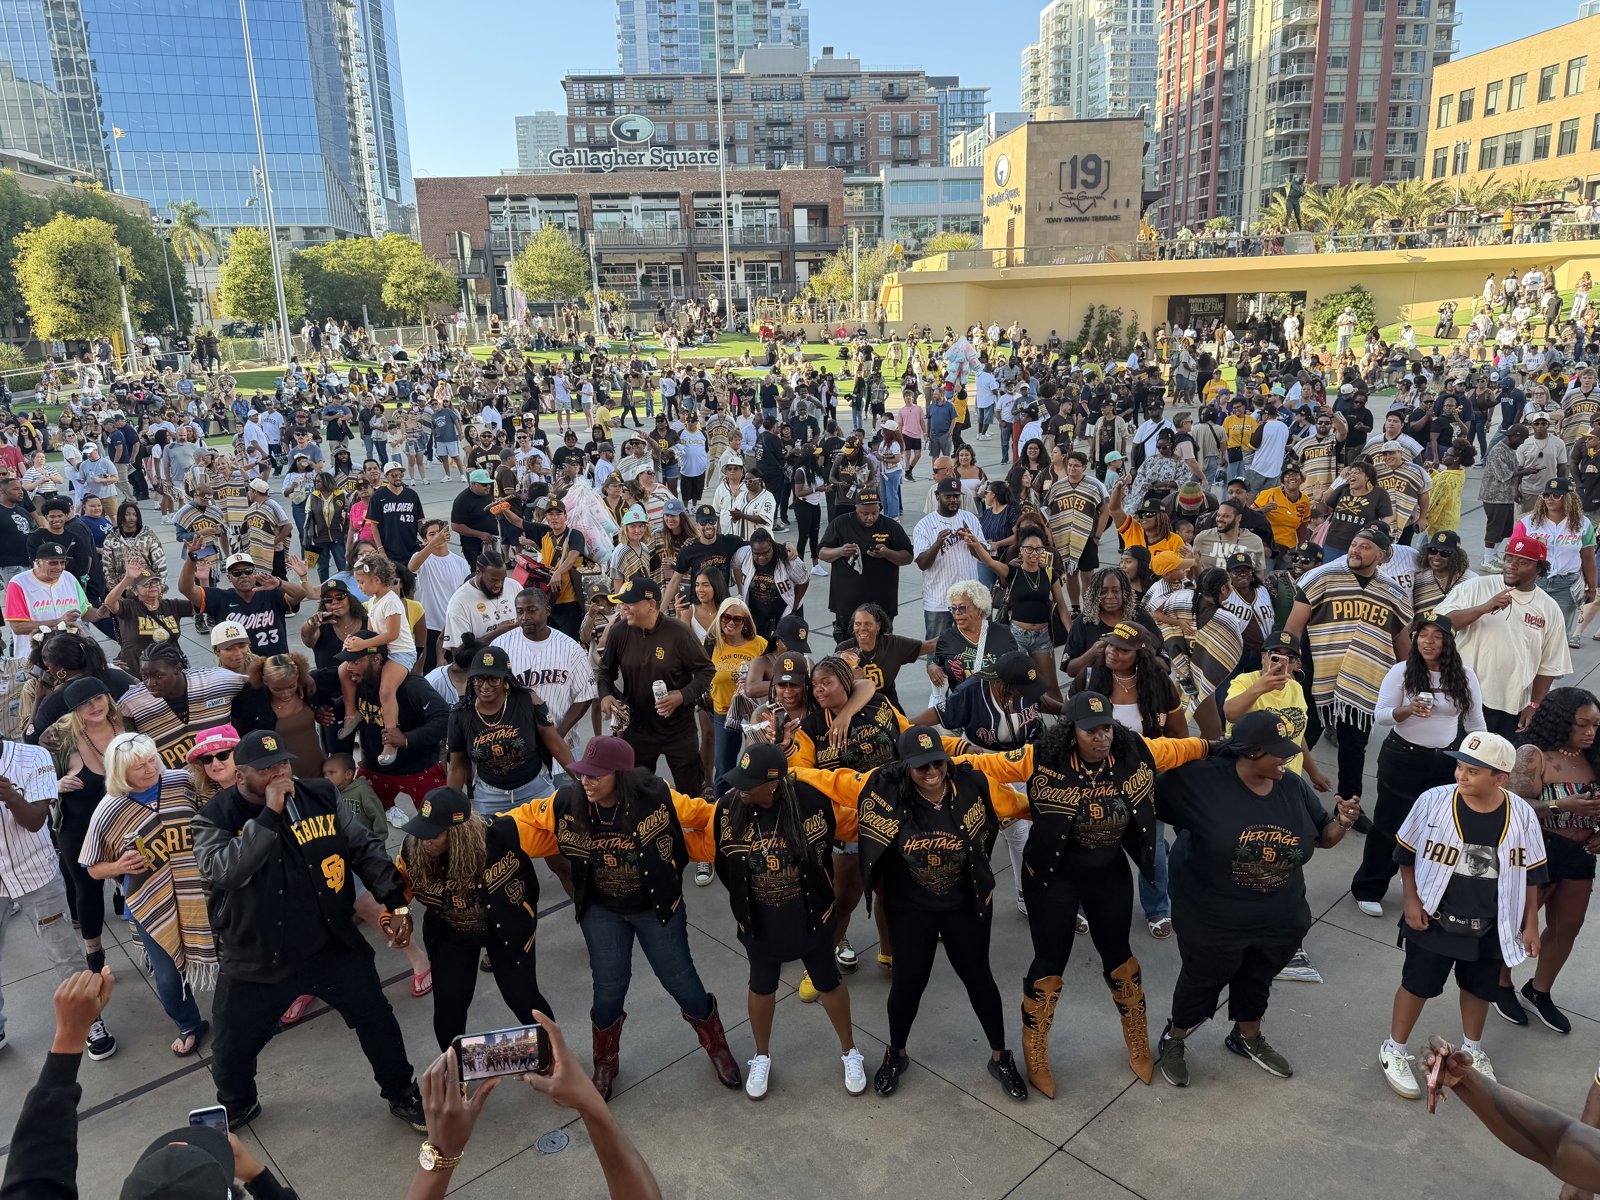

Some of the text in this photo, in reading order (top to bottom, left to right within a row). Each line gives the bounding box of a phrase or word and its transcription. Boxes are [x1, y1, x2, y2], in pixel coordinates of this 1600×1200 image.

[549, 149, 718, 170] Gallagher Square
[1069, 154, 1101, 189] 19
[1092, 214, 1121, 222] TERRACE
[1190, 302, 1224, 312] HALL OF FAME
[383, 502, 414, 513] SAN DIEGO
[1057, 496, 1087, 511] PAES
[1210, 542, 1247, 558] JUST
[245, 609, 275, 629] DIEGO
[1332, 600, 1389, 627] PADRES
[1524, 612, 1546, 629] Reign
[256, 629, 279, 646] 23
[1122, 624, 1138, 637] DIEGO
[655, 646, 665, 660] SD
[733, 653, 752, 662] DIEGO
[783, 658, 794, 671] SD
[261, 736, 278, 752] SD
[473, 727, 520, 749] HERITAGE
[1468, 735, 1481, 751] SD
[491, 744, 505, 757] SD
[1037, 764, 1056, 779] WOMEN
[1029, 774, 1081, 806] South
[870, 790, 893, 812] WOMEN OF
[858, 798, 900, 838] South
[963, 796, 986, 832] ast
[1089, 803, 1104, 819] SD
[637, 804, 669, 838] east
[903, 837, 964, 856] HERITAGE
[1238, 830, 1300, 849] HERITAGE
[602, 853, 617, 867] SD
[927, 854, 940, 866] SD
[1262, 847, 1276, 861] SD
[1422, 840, 1527, 867] PAD RE
[483, 851, 520, 884] east
[766, 855, 780, 871] SD
